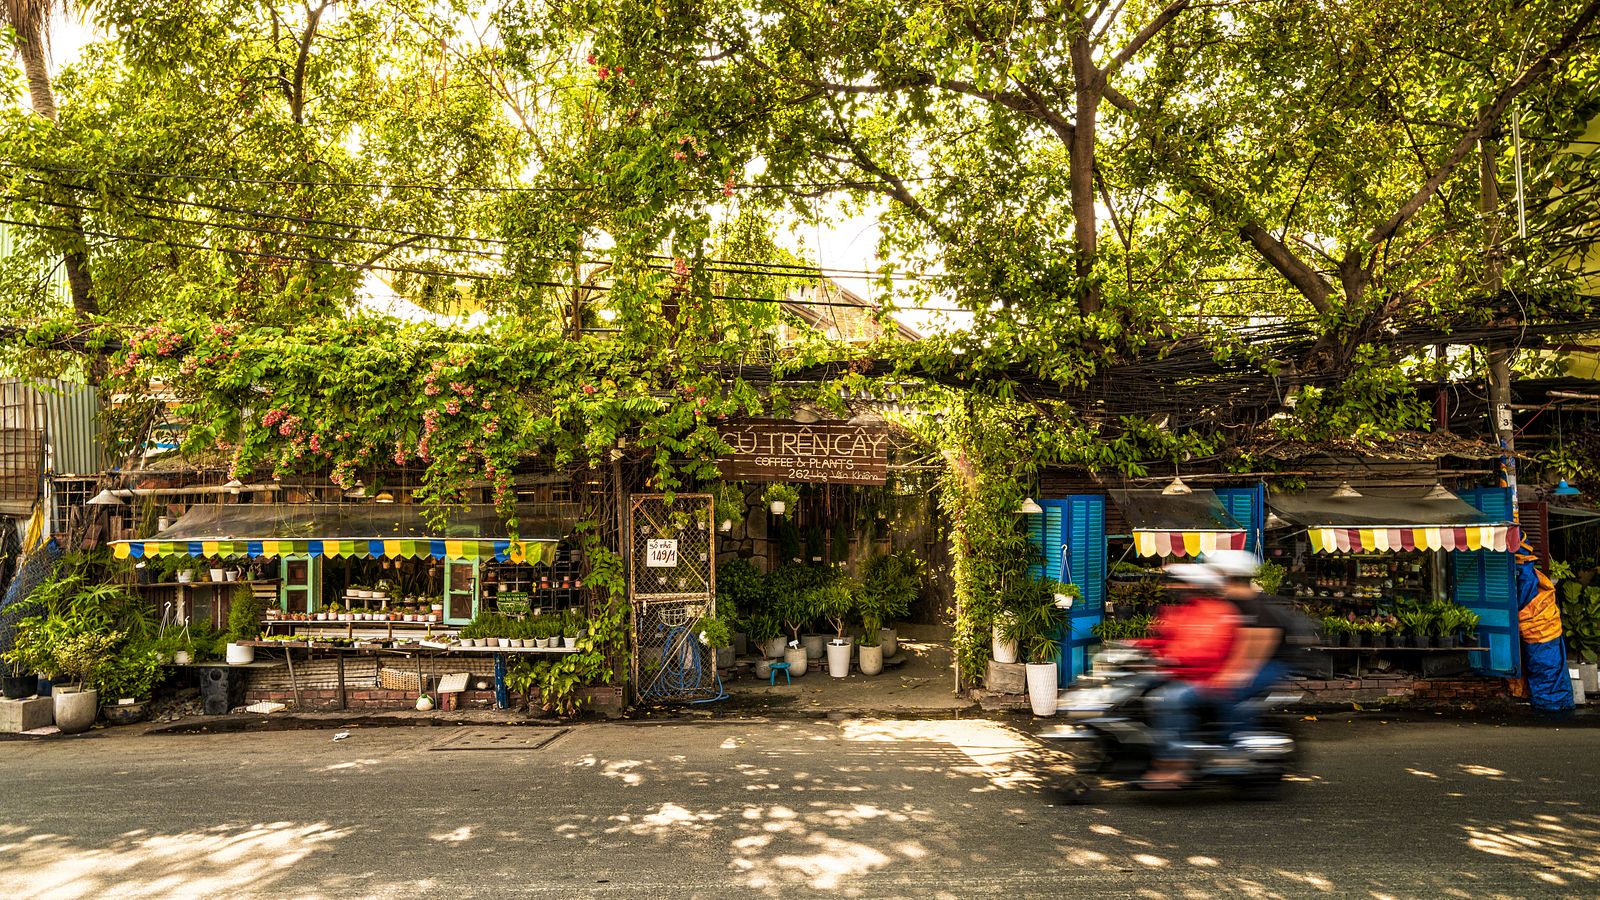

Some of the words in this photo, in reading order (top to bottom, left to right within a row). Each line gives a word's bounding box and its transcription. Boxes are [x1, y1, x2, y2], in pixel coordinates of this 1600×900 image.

[763, 426, 830, 455] TRÊN
[834, 427, 887, 458] CÂY
[755, 457, 793, 468] COFFEE
[796, 457, 806, 468] &
[809, 459, 854, 470] PLANTS
[788, 469, 810, 480] 262
